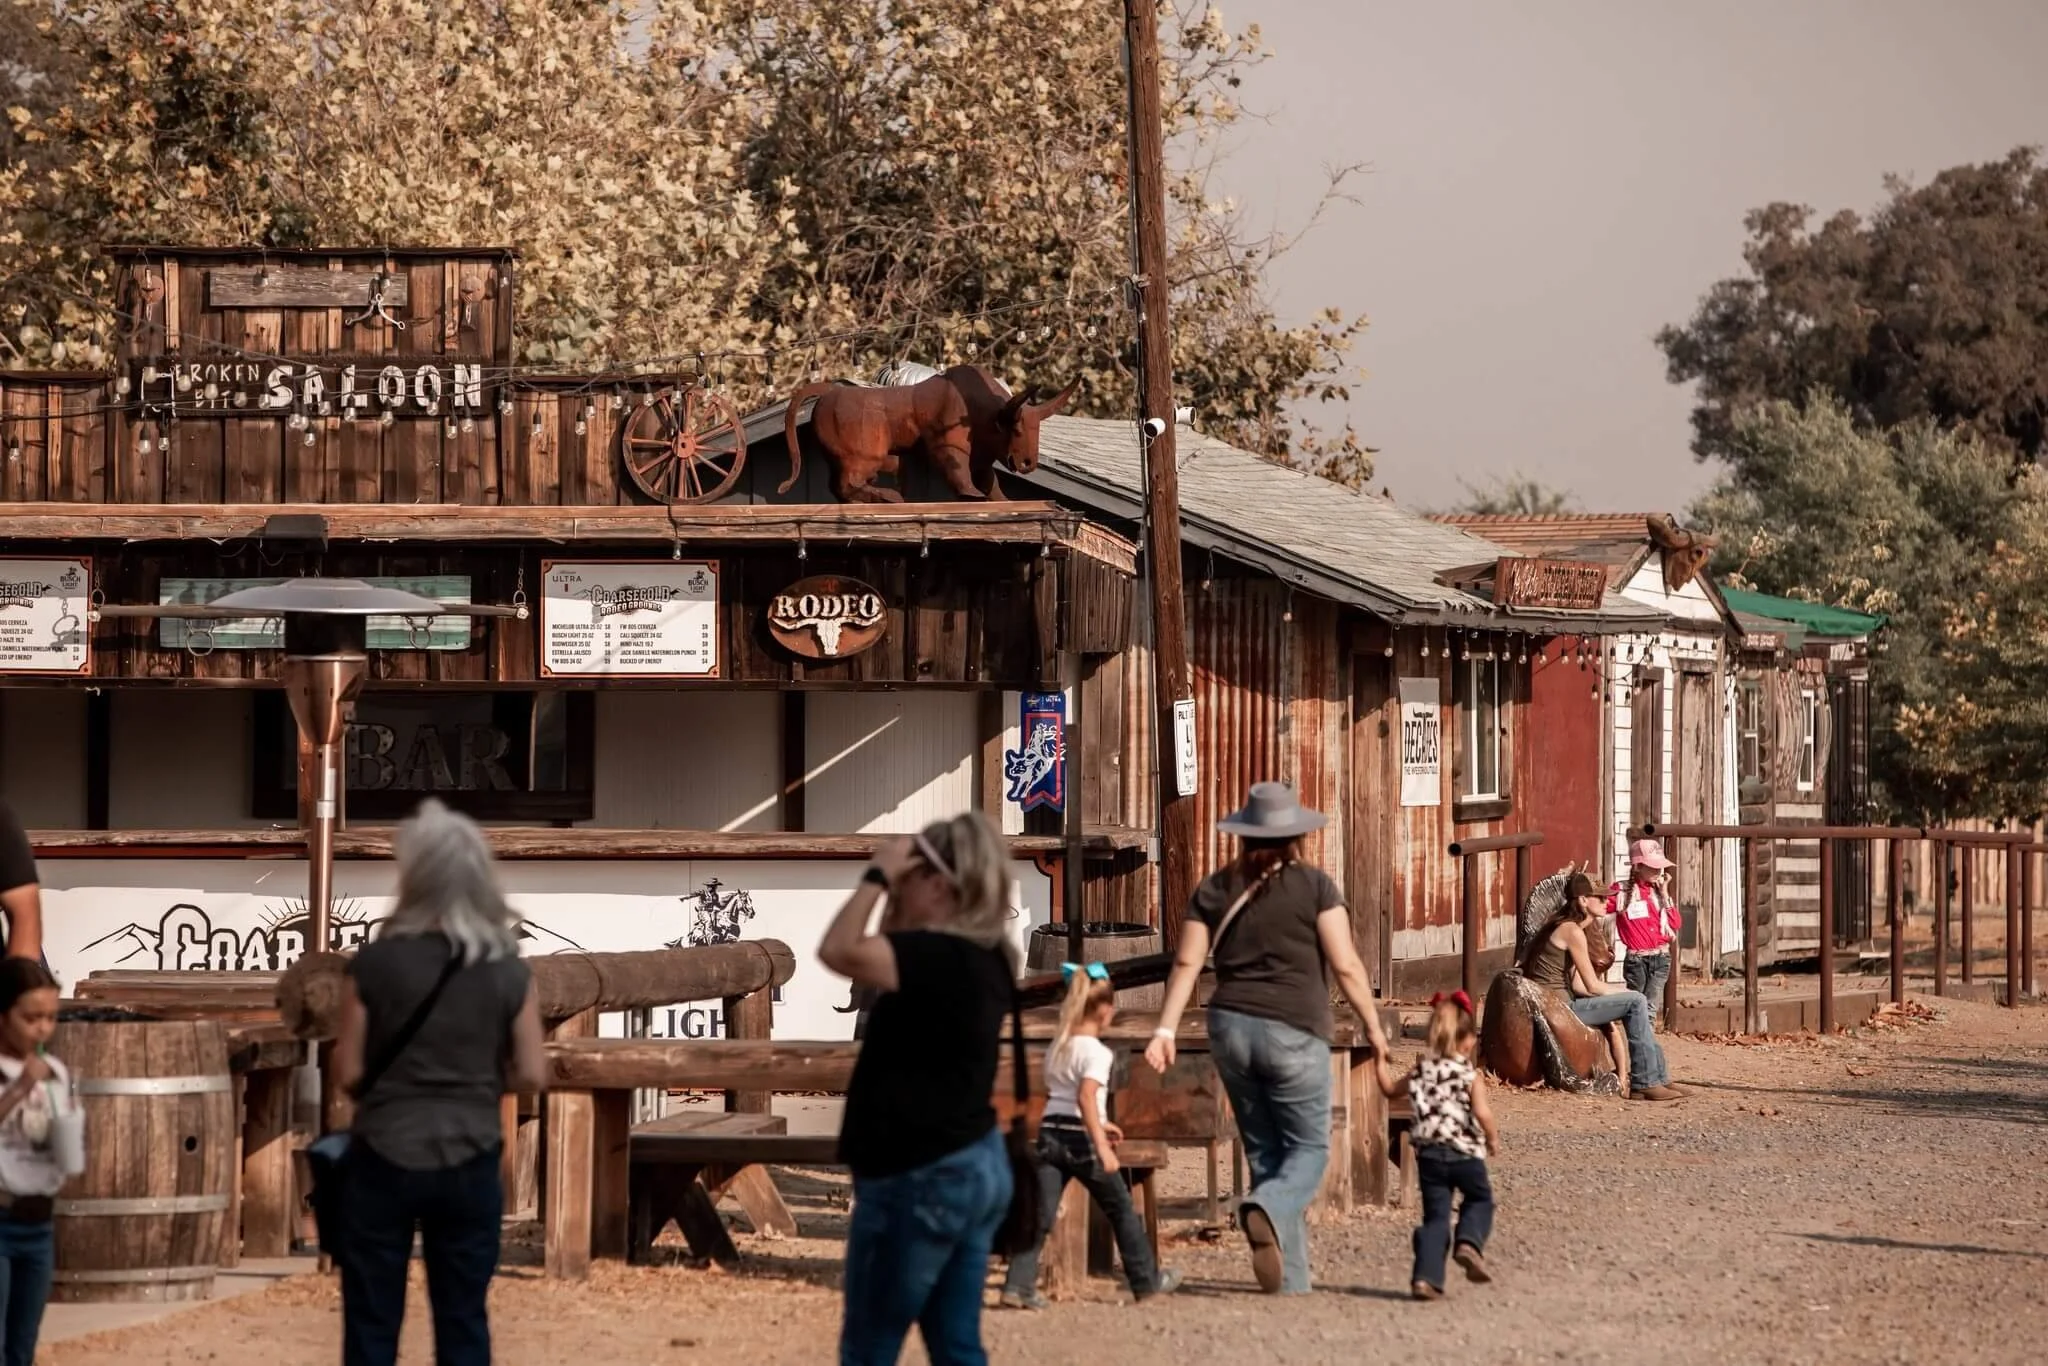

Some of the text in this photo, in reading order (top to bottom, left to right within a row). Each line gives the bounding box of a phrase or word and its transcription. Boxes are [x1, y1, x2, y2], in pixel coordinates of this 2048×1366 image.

[268, 364, 480, 408] SALOON
[591, 585, 670, 606] COARSEGOLD
[600, 601, 662, 616] RODEO GROUNDS
[776, 594, 880, 618] RODEO
[346, 723, 518, 790] BAR
[652, 1009, 725, 1038] IGH
